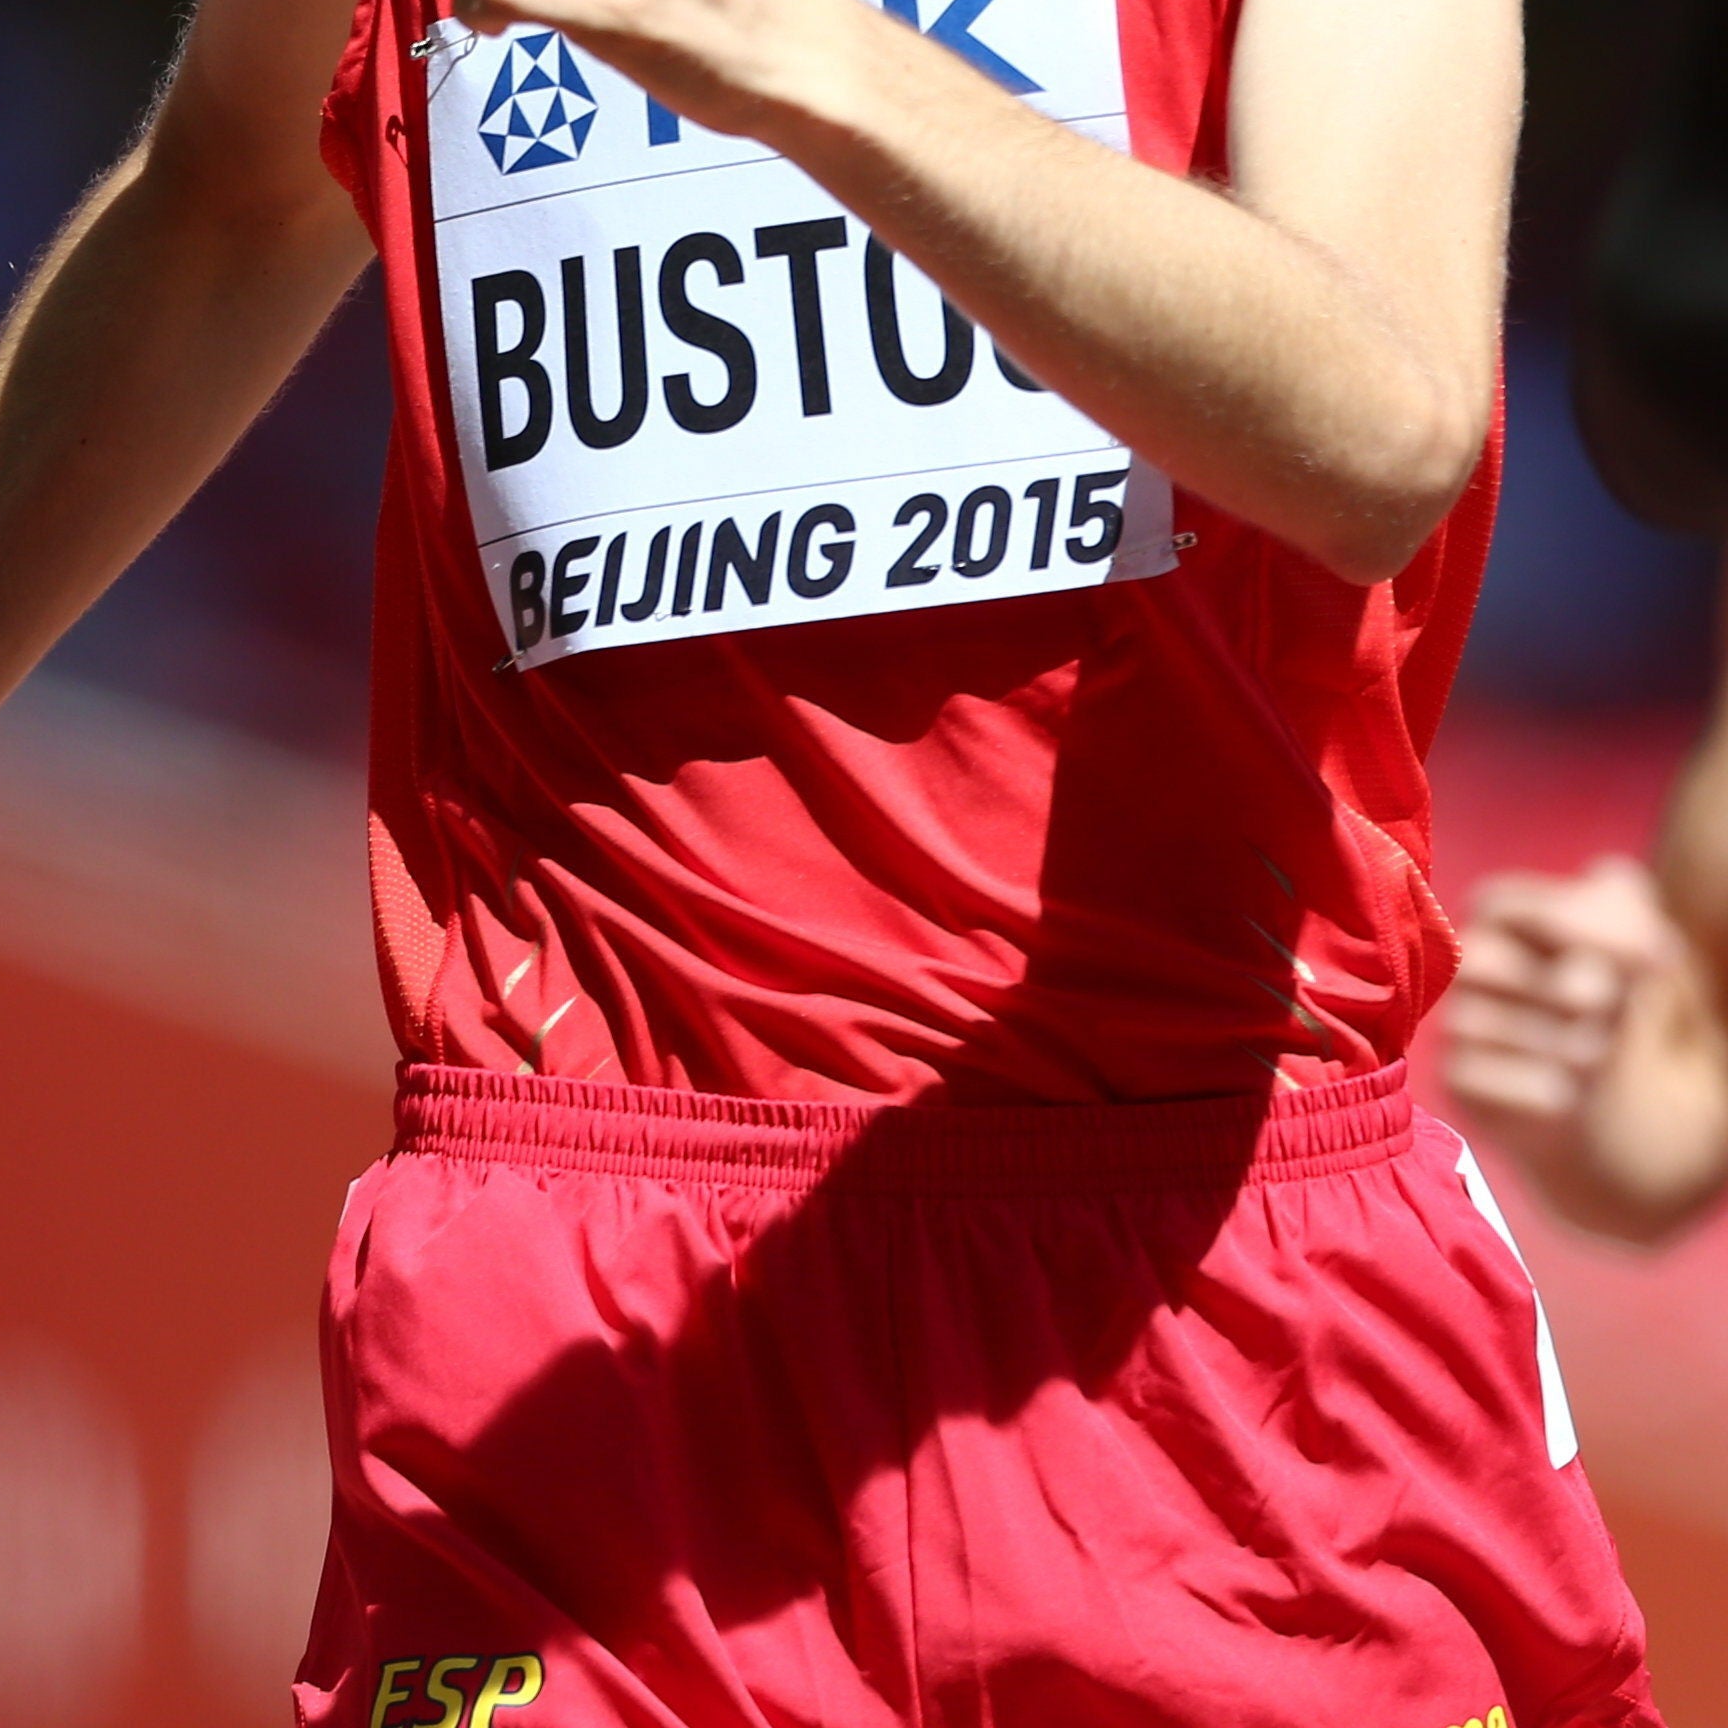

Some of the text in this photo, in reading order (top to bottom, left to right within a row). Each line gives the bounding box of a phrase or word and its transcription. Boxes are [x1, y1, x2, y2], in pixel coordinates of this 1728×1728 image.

[470, 216, 1058, 472] BUSTO
[510, 469, 1130, 652] BEIJING 2015
